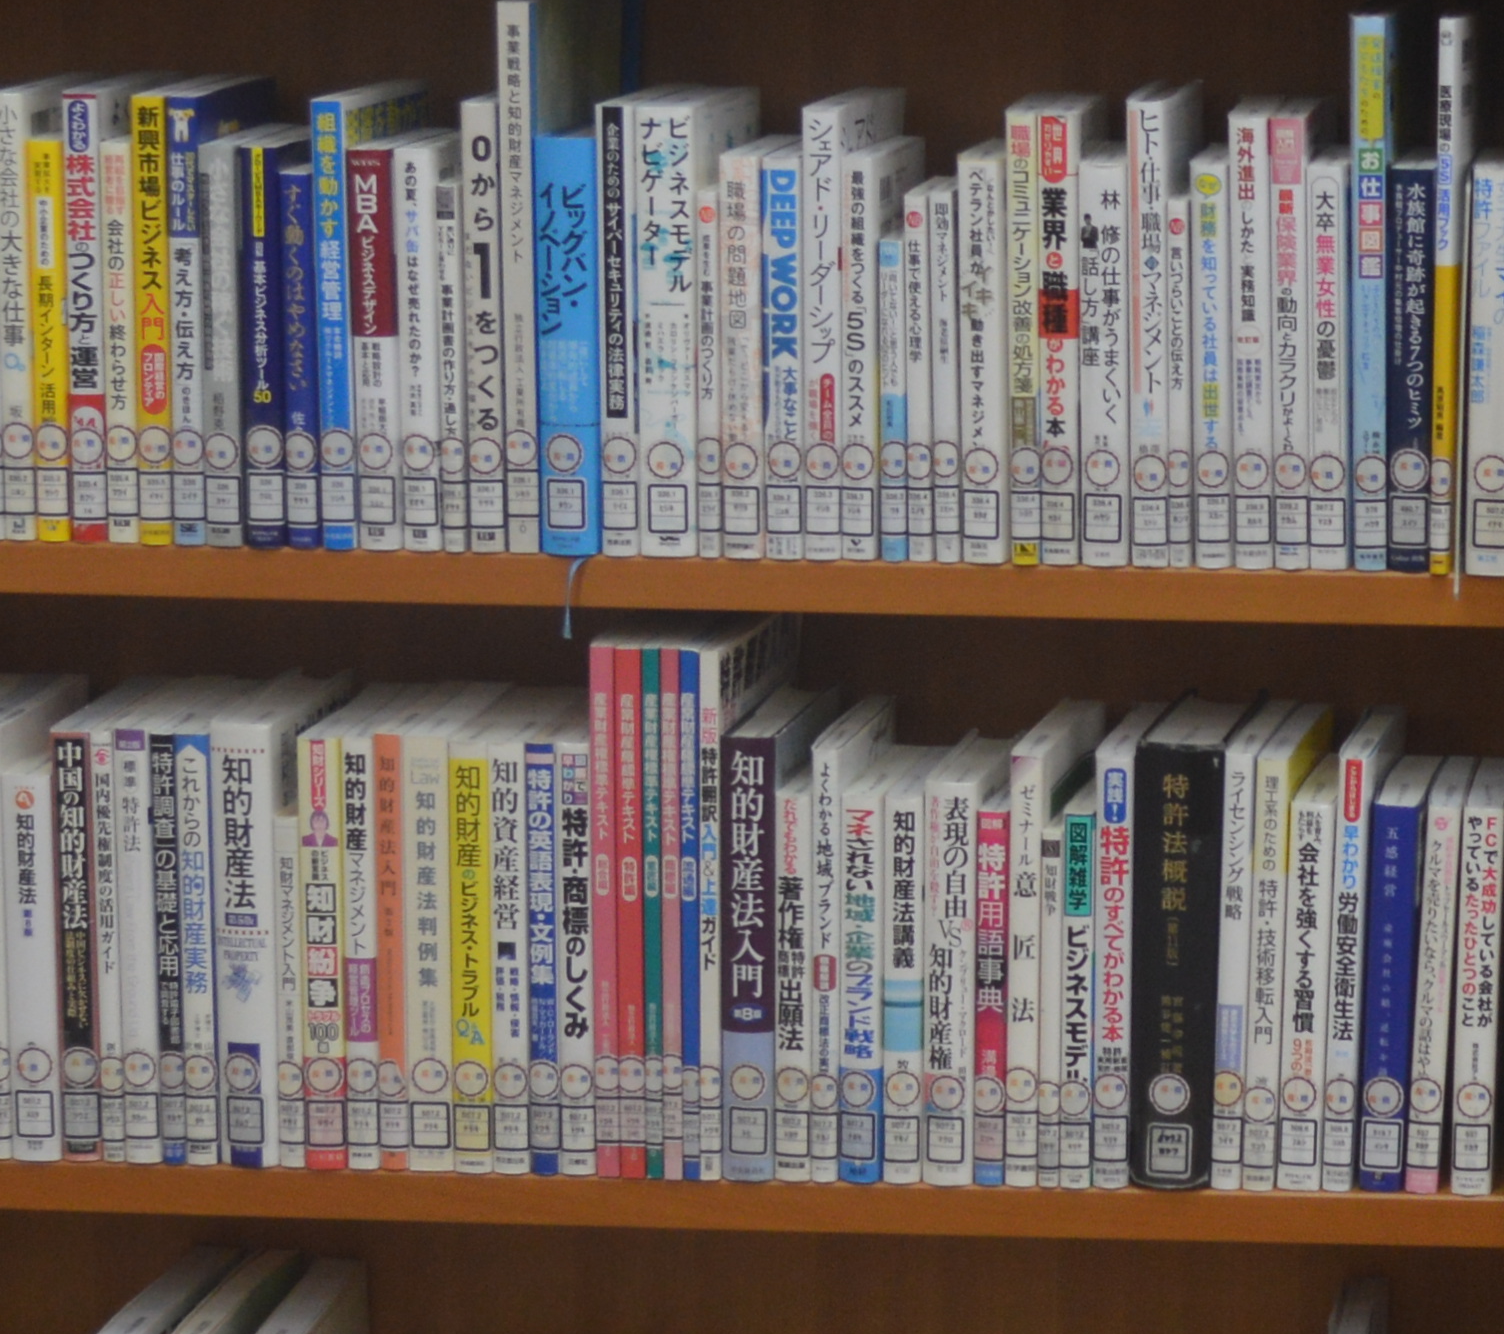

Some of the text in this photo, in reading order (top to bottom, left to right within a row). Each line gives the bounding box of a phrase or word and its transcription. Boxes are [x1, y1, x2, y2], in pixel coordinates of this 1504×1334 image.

[135, 105, 166, 342] 新興市場ビジネス入門
[505, 23, 525, 265] 事業戦略と知的財産マネジメント
[1358, 148, 1384, 279] お仕事図鑑
[67, 153, 99, 391] 株式会社のつくり方と運営
[107, 220, 127, 412] 会社の正しい終わらせ方
[470, 134, 499, 433] 0から1をつくる
[770, 169, 797, 360] DEEP WORK
[807, 117, 836, 366] シェアド・リーダーシップ
[906, 238, 922, 365] 仕事で使える心理学
[1169, 245, 1185, 391] 言いづらいことの伝え方
[1314, 191, 1337, 382] 大卒無業女性の憂鬱
[1406, 181, 1426, 430] 水族館に奇跡が起きる7つのヒミツ
[15, 813, 38, 907] 知的財産法
[56, 740, 90, 931] 中国の知的財産法
[220, 754, 260, 912] 知的財産法
[492, 757, 520, 933] 知的資産経営
[527, 768, 558, 985] 特許の英語表現・文例集
[730, 749, 765, 999] 知的財産法入門
[892, 810, 916, 970] 知的財産法講義
[975, 842, 1006, 1014] 特許用語事典
[1160, 772, 1190, 912] 特許法概説
[1224, 771, 1248, 921] ライセンシング戦略
[1098, 825, 1130, 1043] 特許のすべてがわかる本
